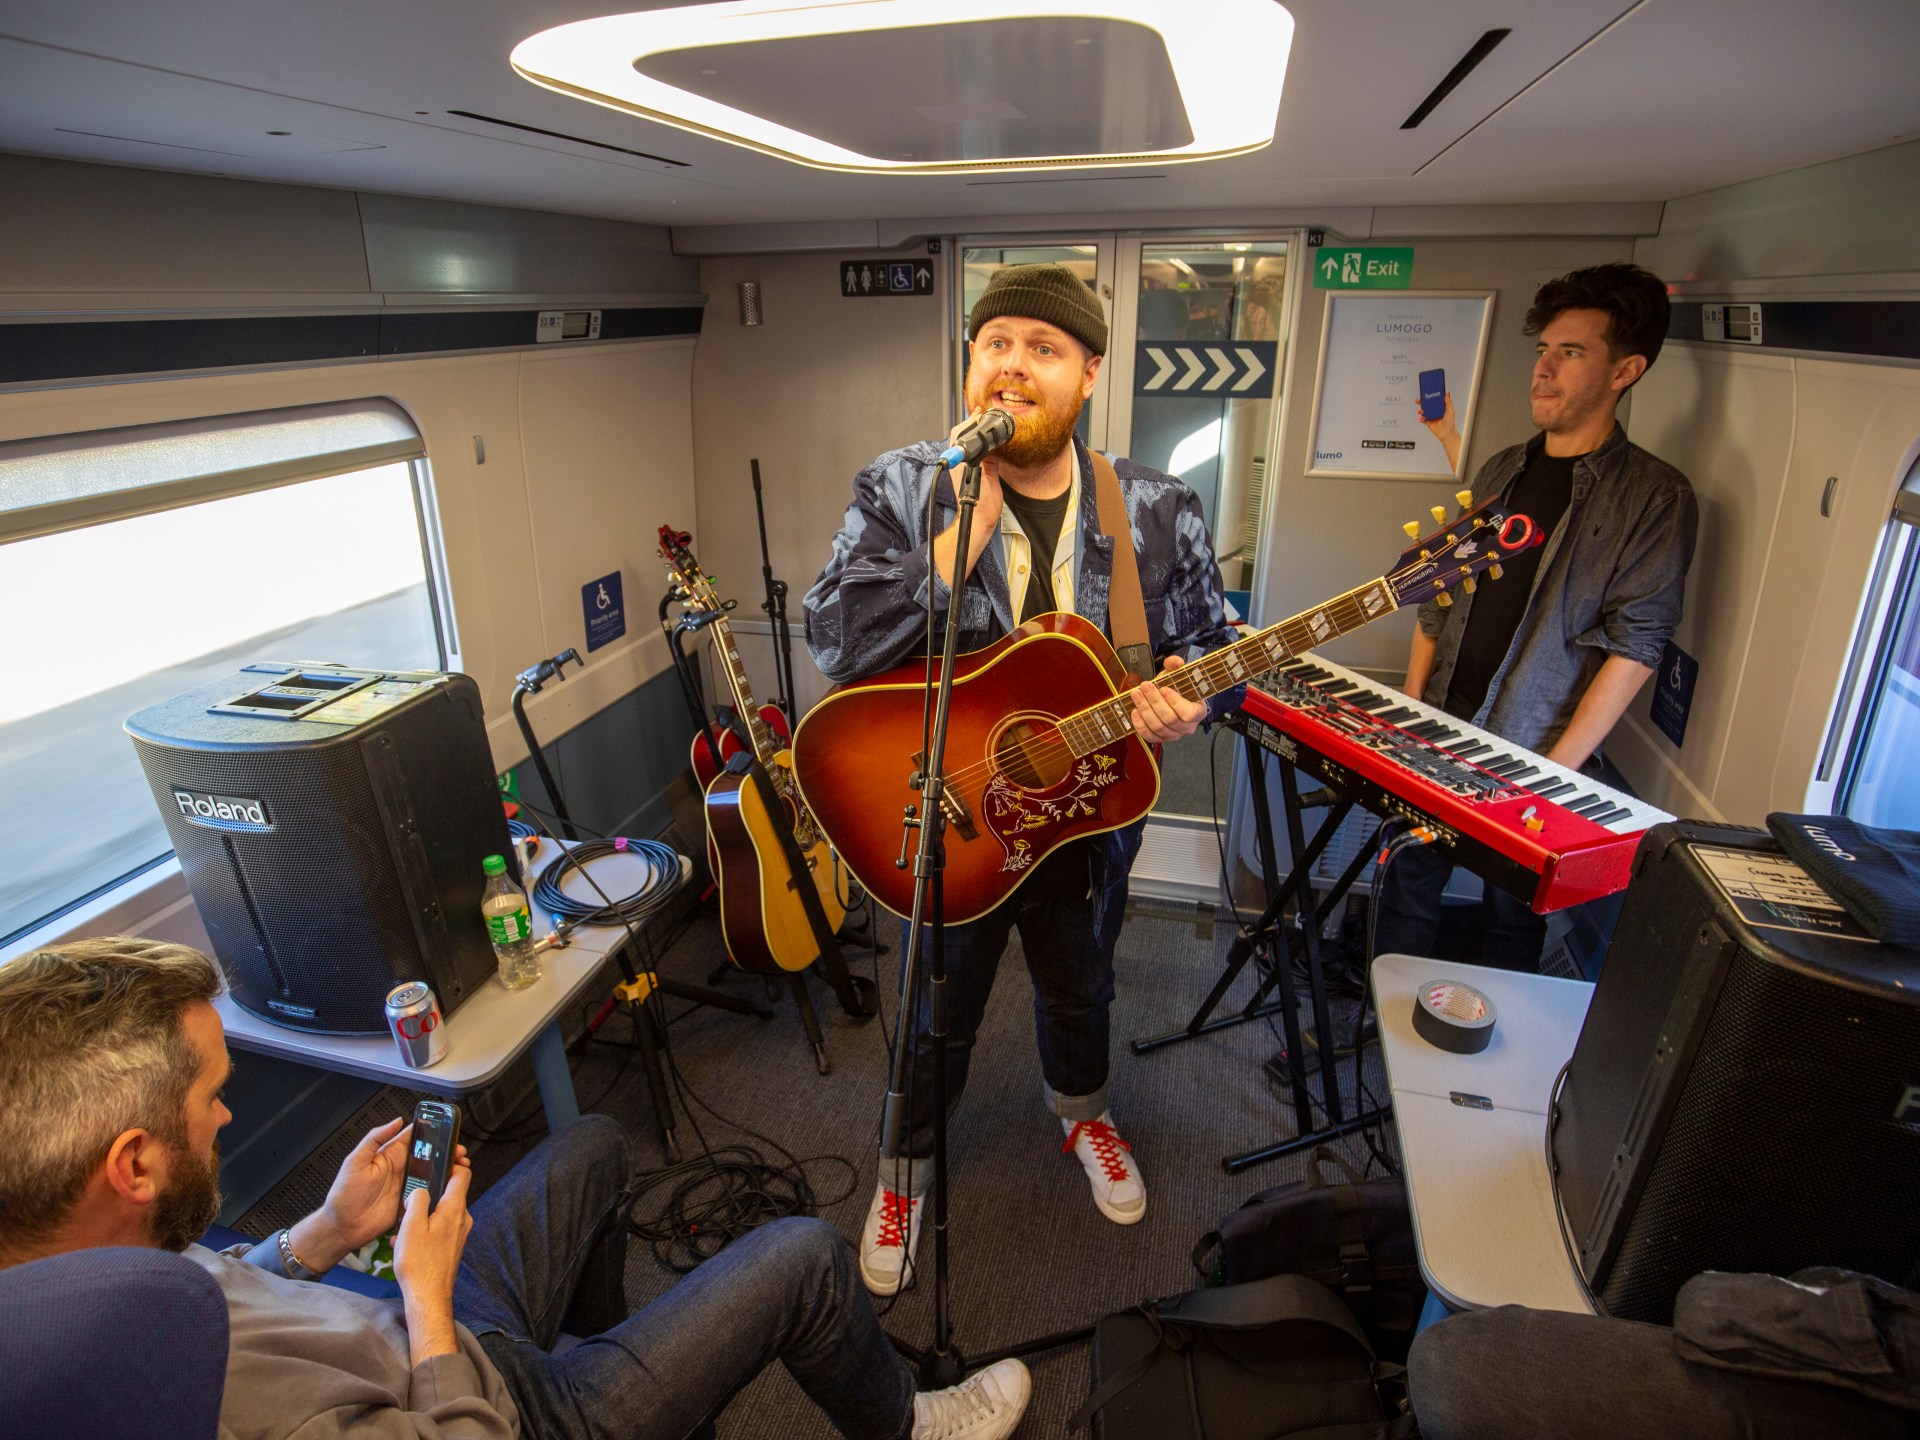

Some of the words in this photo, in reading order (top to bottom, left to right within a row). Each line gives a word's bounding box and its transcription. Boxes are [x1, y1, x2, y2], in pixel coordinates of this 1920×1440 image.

[1309, 234, 1323, 244] K1
[928, 242, 940, 251] K2
[1366, 260, 1400, 276] Exit
[1376, 323, 1432, 334] LUMOGO
[1425, 391, 1441, 399] lumo
[1316, 450, 1343, 460] lumo
[1398, 565, 1435, 591] HUMMINGBIRD
[174, 791, 266, 824] Roland
[1803, 824, 1857, 862] lumo
